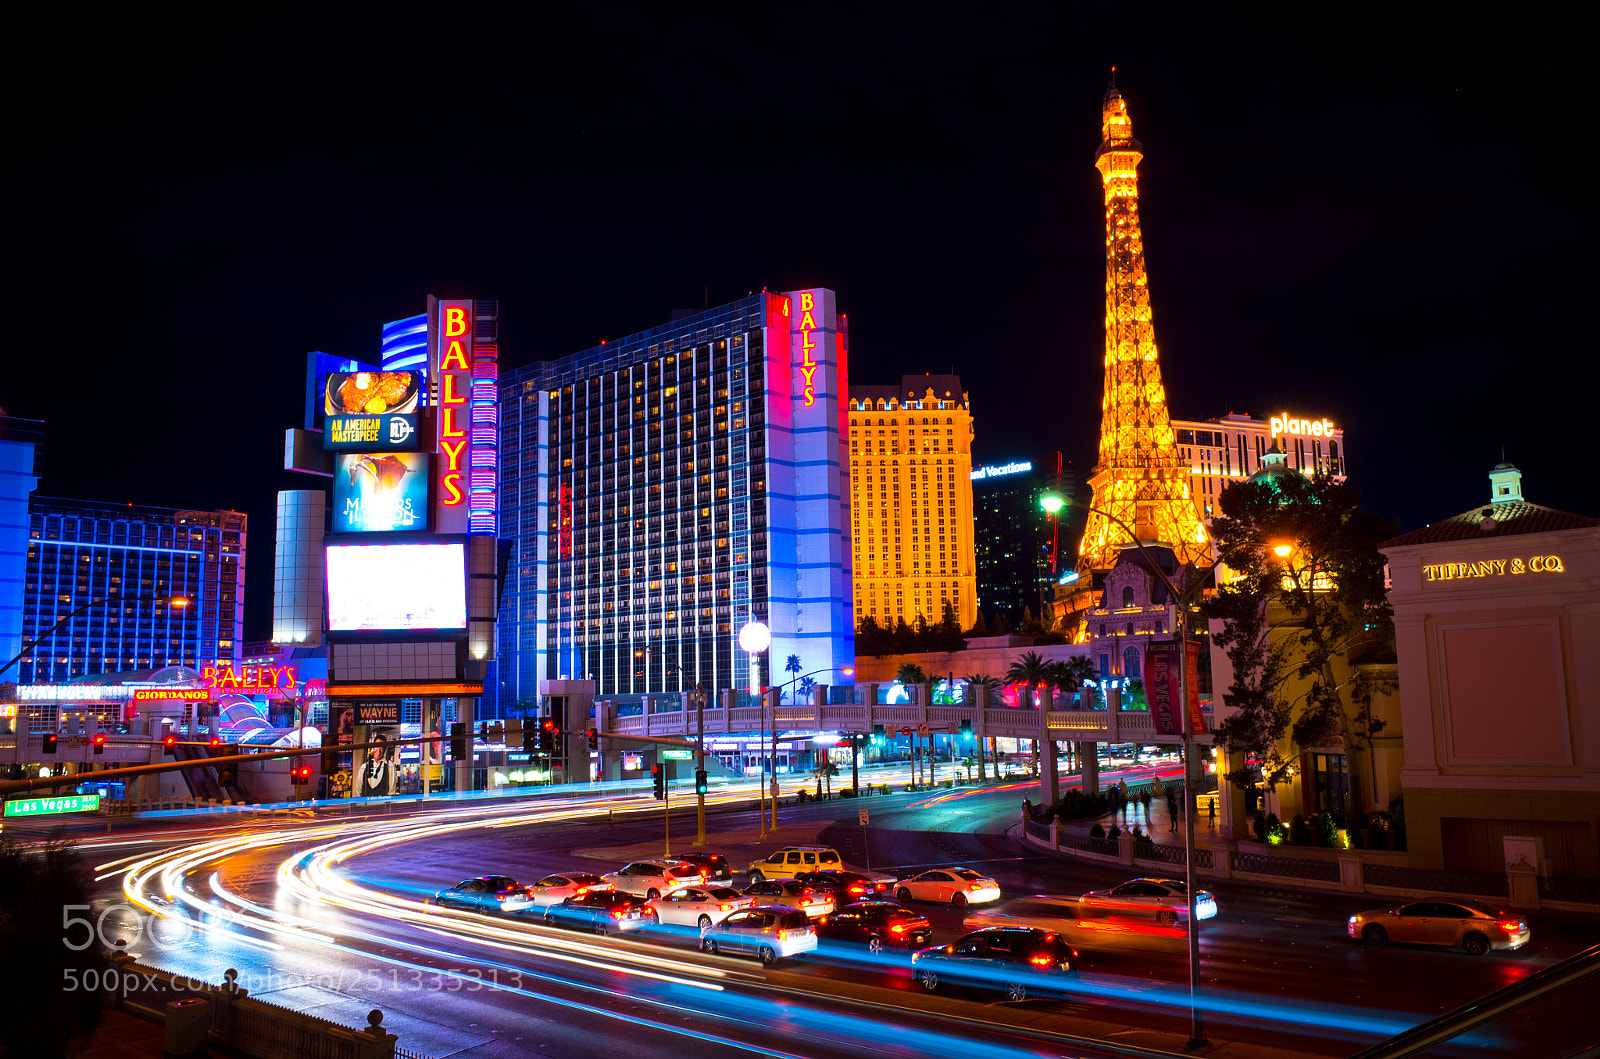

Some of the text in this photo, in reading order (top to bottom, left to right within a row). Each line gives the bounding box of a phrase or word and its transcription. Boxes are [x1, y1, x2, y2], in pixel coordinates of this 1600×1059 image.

[331, 418, 380, 431] AN AMERICAN
[1270, 412, 1334, 438] planet
[331, 429, 379, 442] MASTERPIECE
[986, 462, 1032, 477] Vacations
[1423, 559, 1507, 581] TIFFANY
[1511, 557, 1526, 574] &
[1153, 653, 1168, 682] LAS
[203, 666, 296, 689] BALLY'S
[20, 686, 101, 700] STARBUCKS
[360, 707, 398, 718] WAYNE
[15, 800, 37, 813] Las
[41, 799, 78, 813] Vegas
